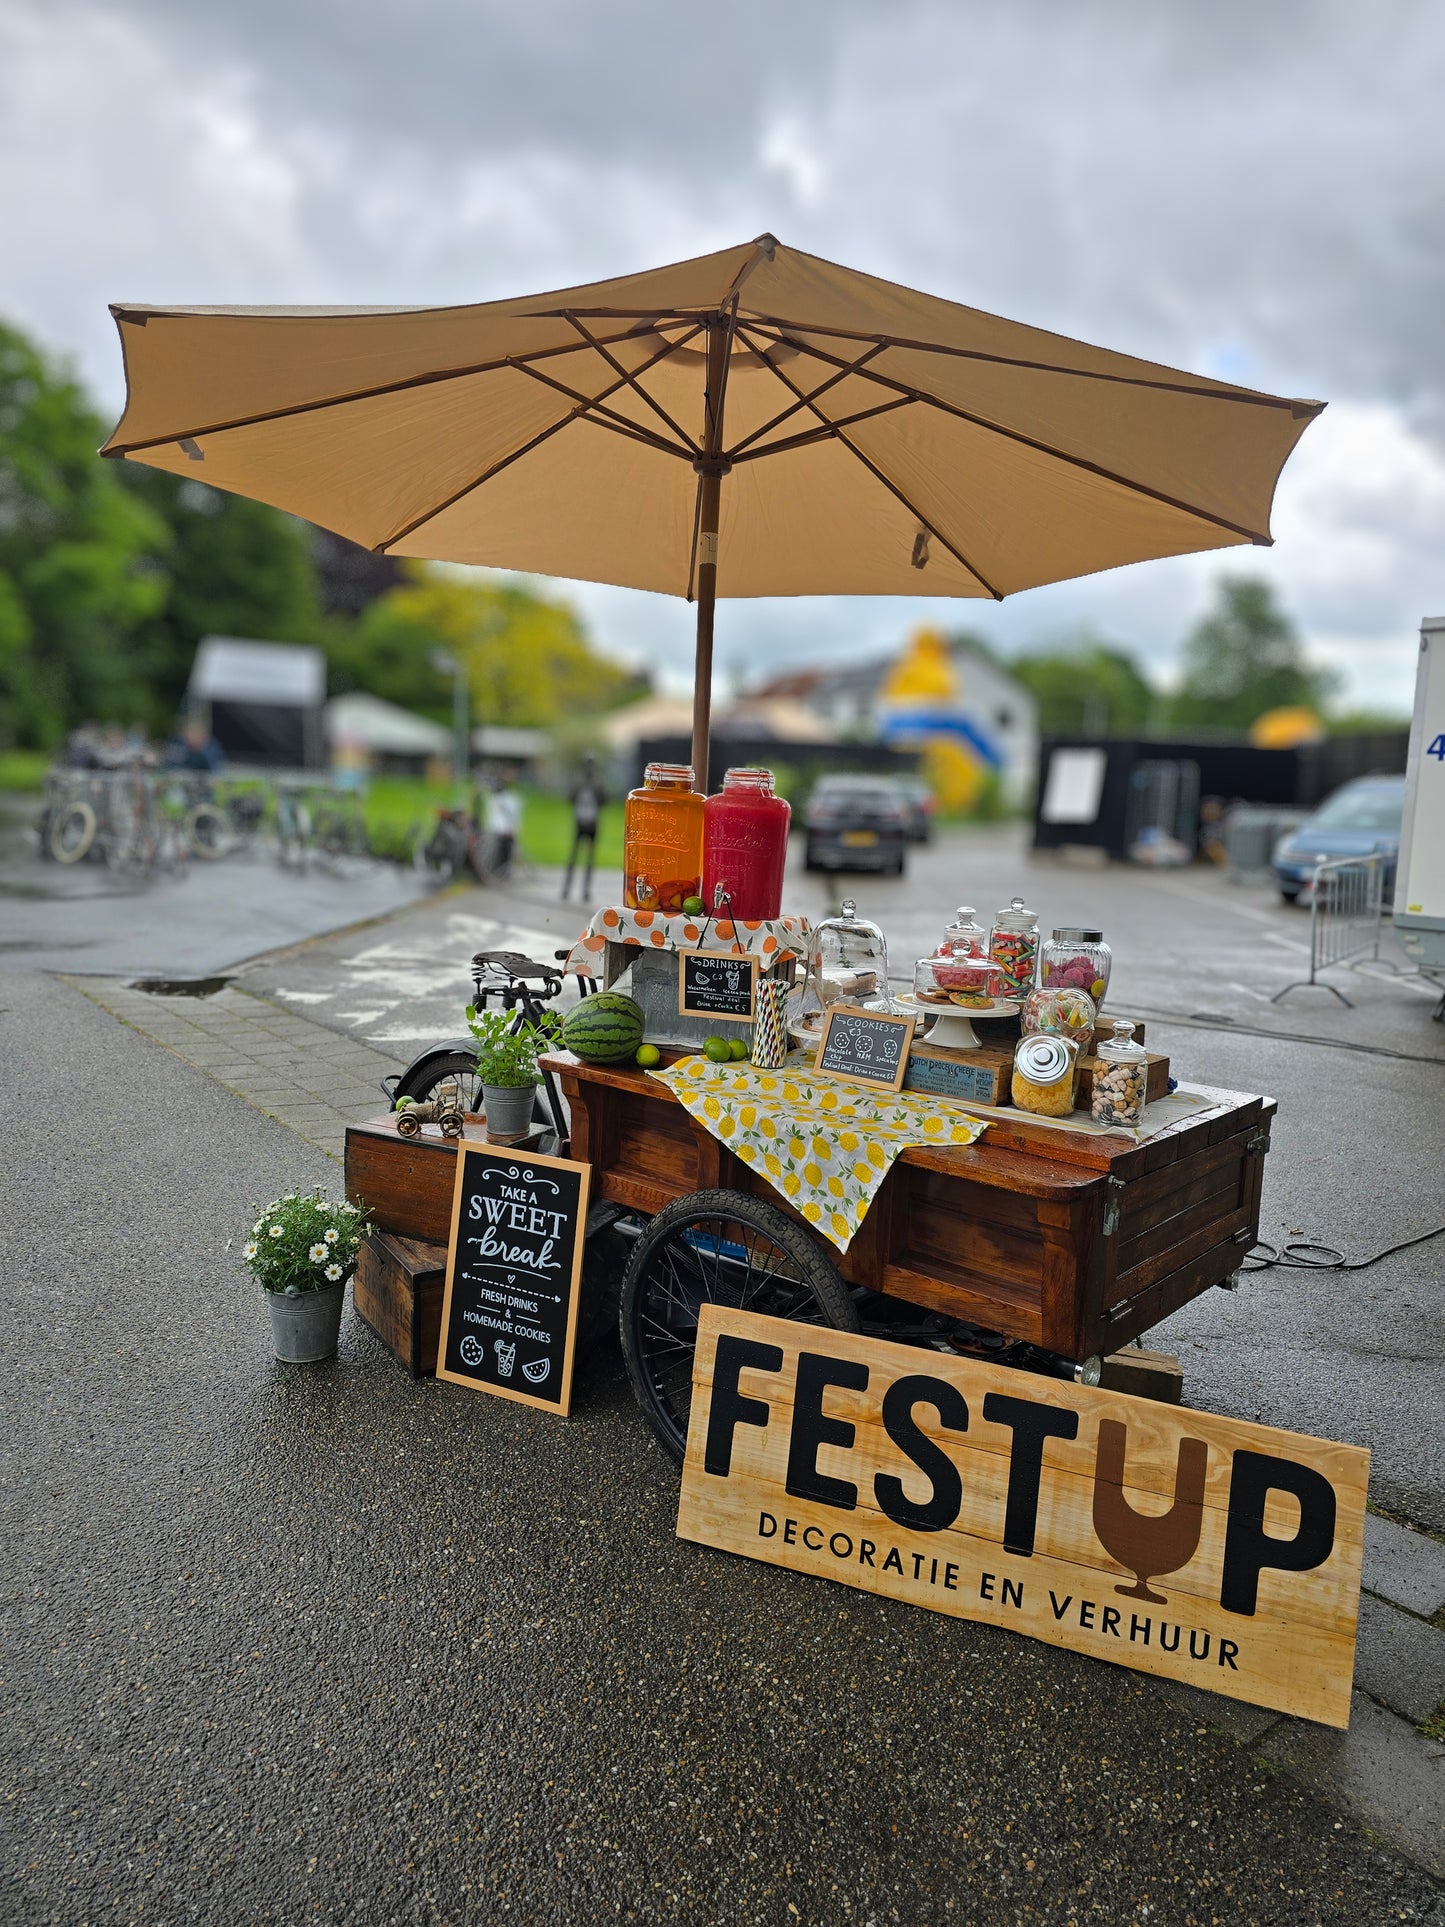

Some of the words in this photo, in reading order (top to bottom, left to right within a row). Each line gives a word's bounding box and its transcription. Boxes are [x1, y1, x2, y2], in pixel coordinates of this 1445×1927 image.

[702, 959, 739, 970] DRINKS
[846, 1017, 890, 1033] COOKIES
[928, 1059, 954, 1075] PROCESS
[954, 1066, 976, 1079] CHEESE
[500, 1184, 527, 1202] TAKE
[529, 1191, 538, 1204] A
[468, 1194, 568, 1240] SWEET
[467, 1225, 562, 1269] break
[480, 1288, 506, 1304] FRESH
[507, 1295, 538, 1313] DRINKS
[504, 1309, 512, 1319] &
[463, 1310, 514, 1334] HOMEMADE
[515, 1324, 551, 1344] COOKIES
[704, 1333, 1337, 1616] FESTUP
[758, 1511, 961, 1591] DECORATIE
[981, 1573, 1025, 1610] EN
[1048, 1590, 1240, 1671] VERHUUR
